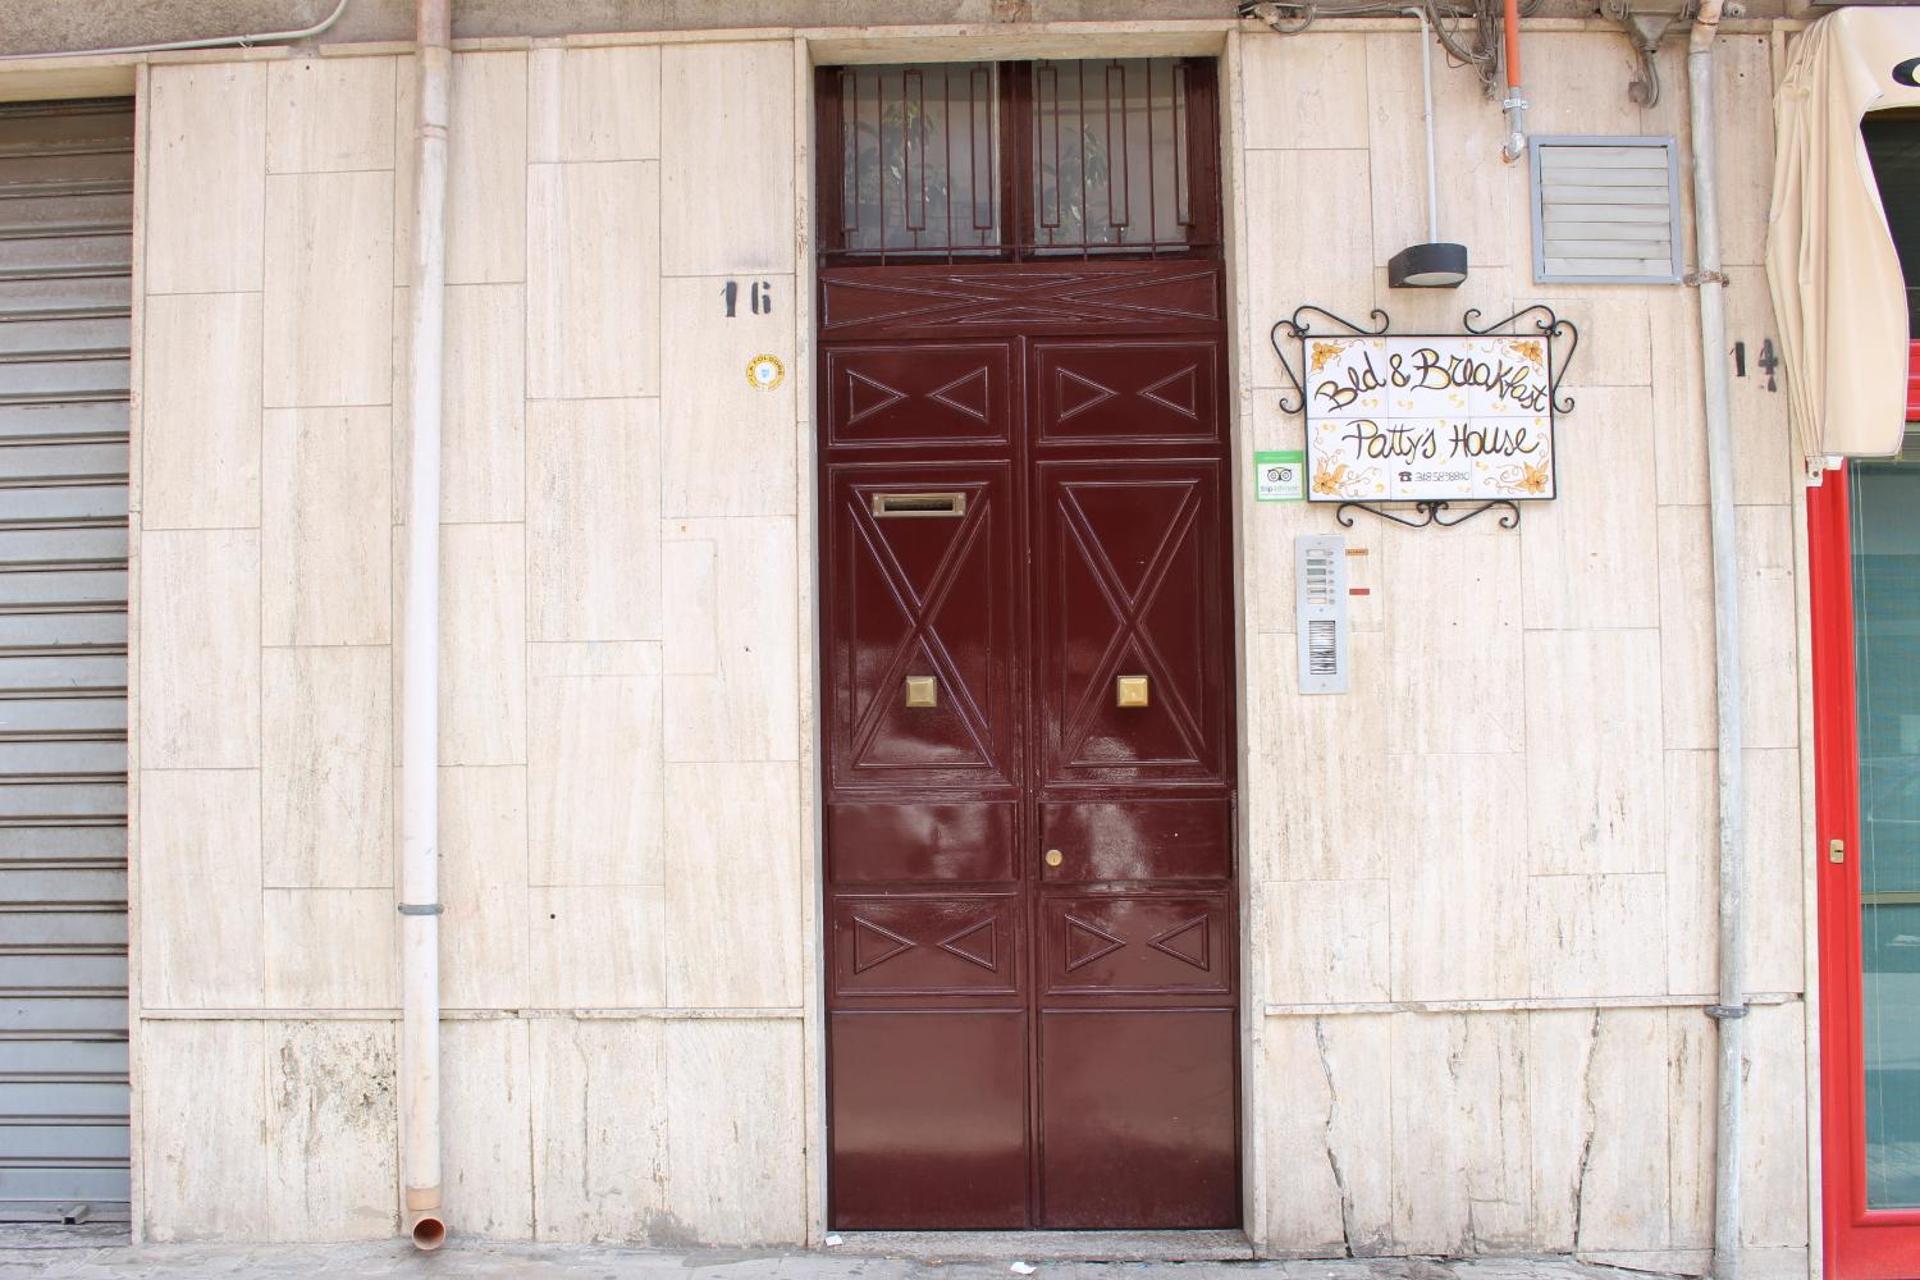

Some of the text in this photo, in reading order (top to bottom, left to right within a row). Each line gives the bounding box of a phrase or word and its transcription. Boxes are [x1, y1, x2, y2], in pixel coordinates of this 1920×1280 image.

[720, 281, 771, 317] 16
[1314, 347, 1548, 413] Bed & Breakfast
[1341, 419, 1540, 466] Patty's House
